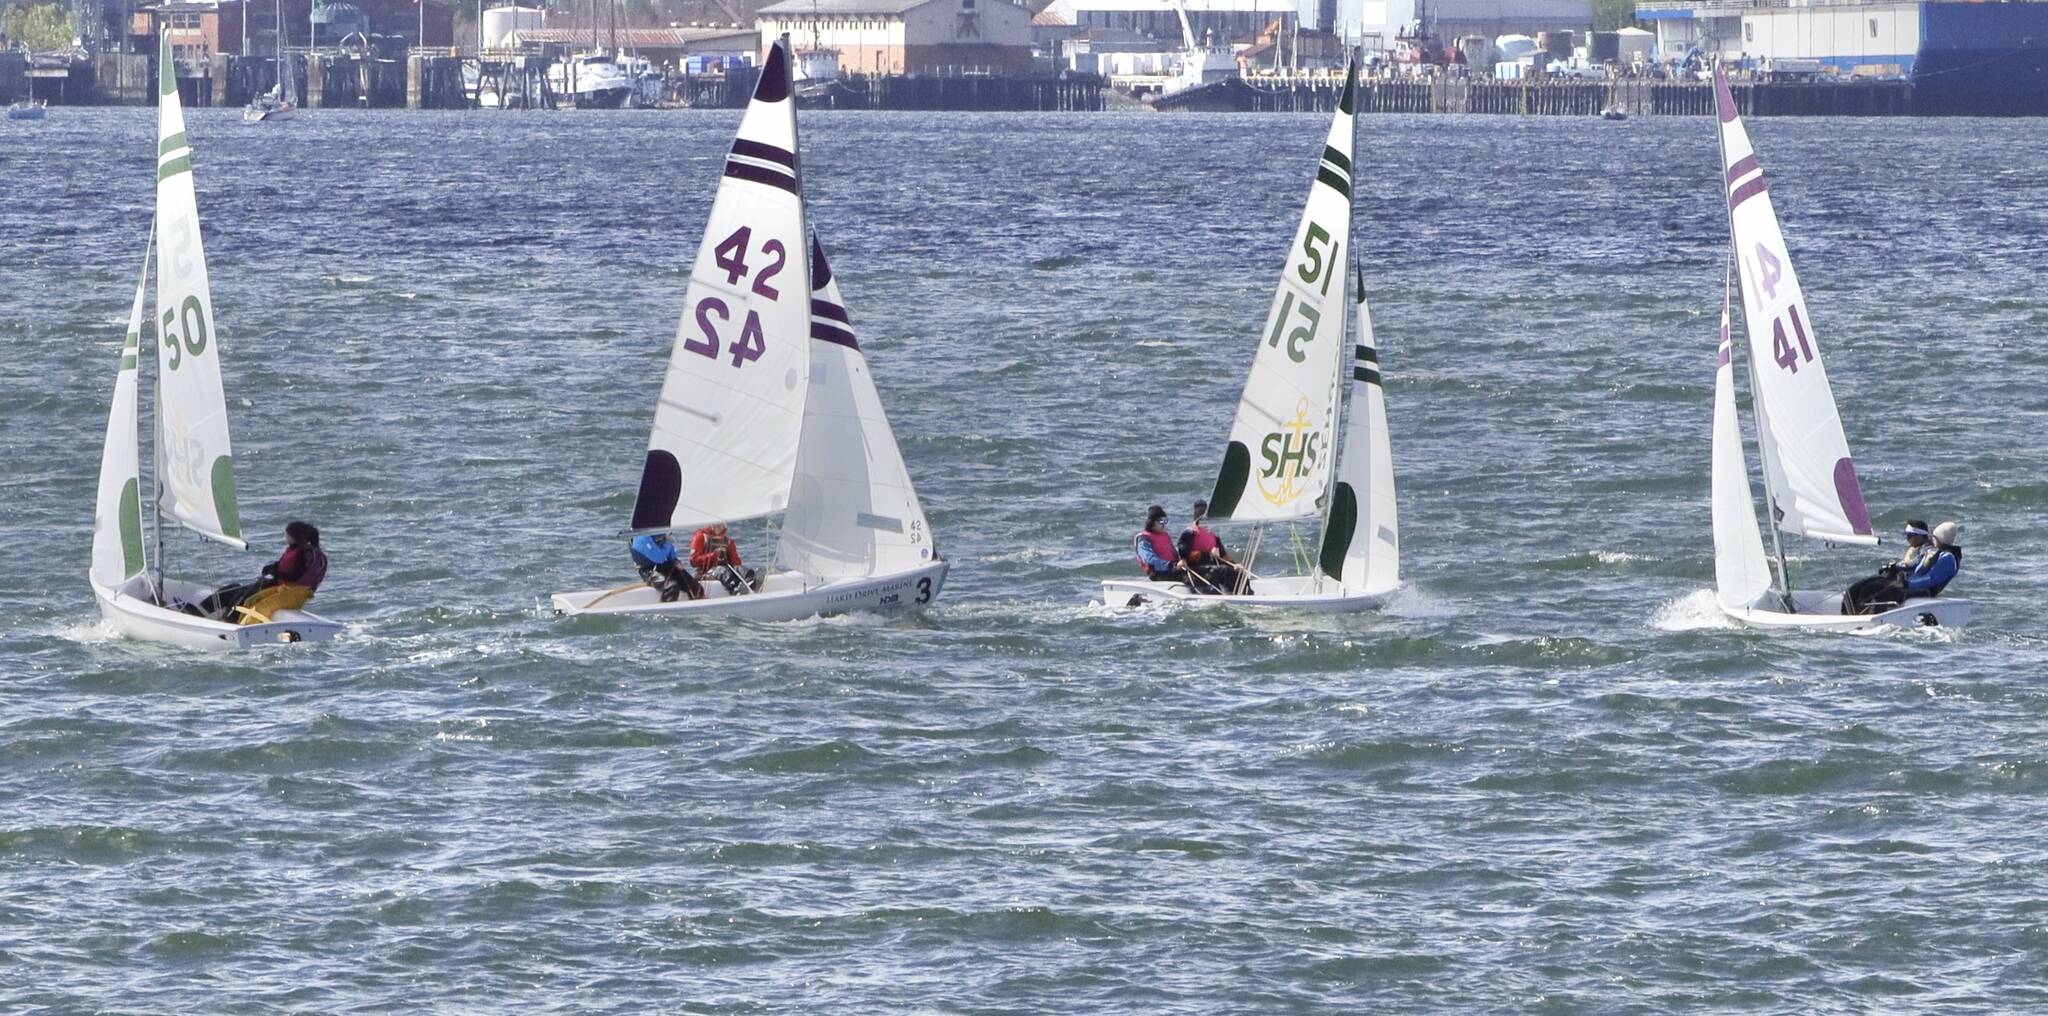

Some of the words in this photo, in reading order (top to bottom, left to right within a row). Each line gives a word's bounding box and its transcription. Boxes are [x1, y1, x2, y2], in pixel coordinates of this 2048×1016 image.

[714, 225, 786, 302] 42
[1298, 220, 1339, 297] 51
[162, 294, 207, 371] 50
[1773, 304, 1814, 375] 41
[1261, 431, 1320, 478] SHS
[911, 520, 922, 531] 42
[826, 593, 853, 604] HARD
[855, 588, 879, 599] DRIVE
[882, 579, 913, 593] MARINE
[914, 576, 932, 605] 3
